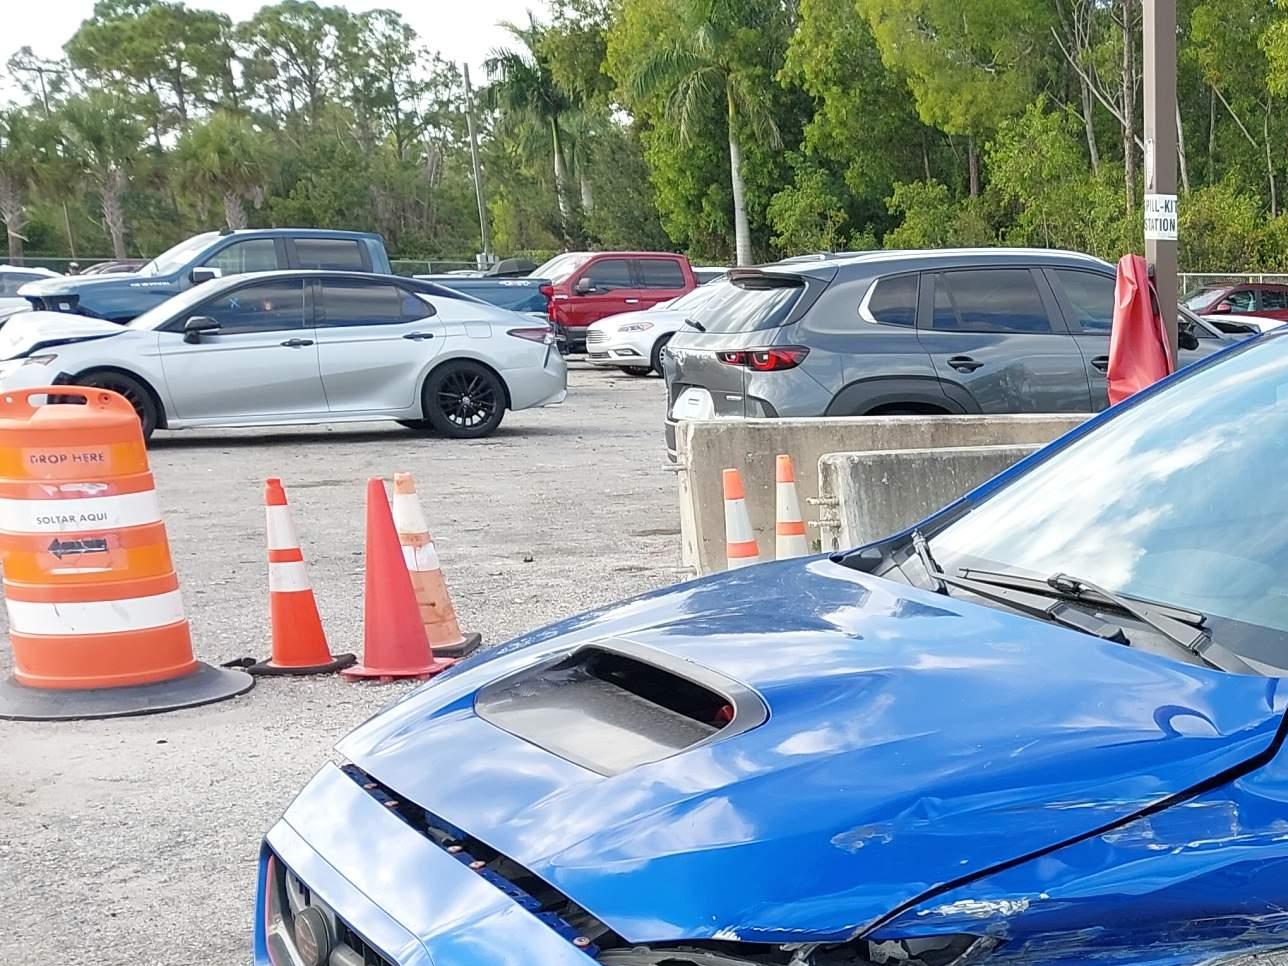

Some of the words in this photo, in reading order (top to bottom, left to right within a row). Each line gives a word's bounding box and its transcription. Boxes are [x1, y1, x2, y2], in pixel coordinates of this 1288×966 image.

[1144, 199, 1177, 213] PILL-KIT
[1144, 218, 1176, 232] STATION
[30, 454, 67, 464] DROP
[72, 452, 104, 462] HERE
[36, 515, 76, 525] SOLTAR
[80, 512, 107, 521] AQUI
